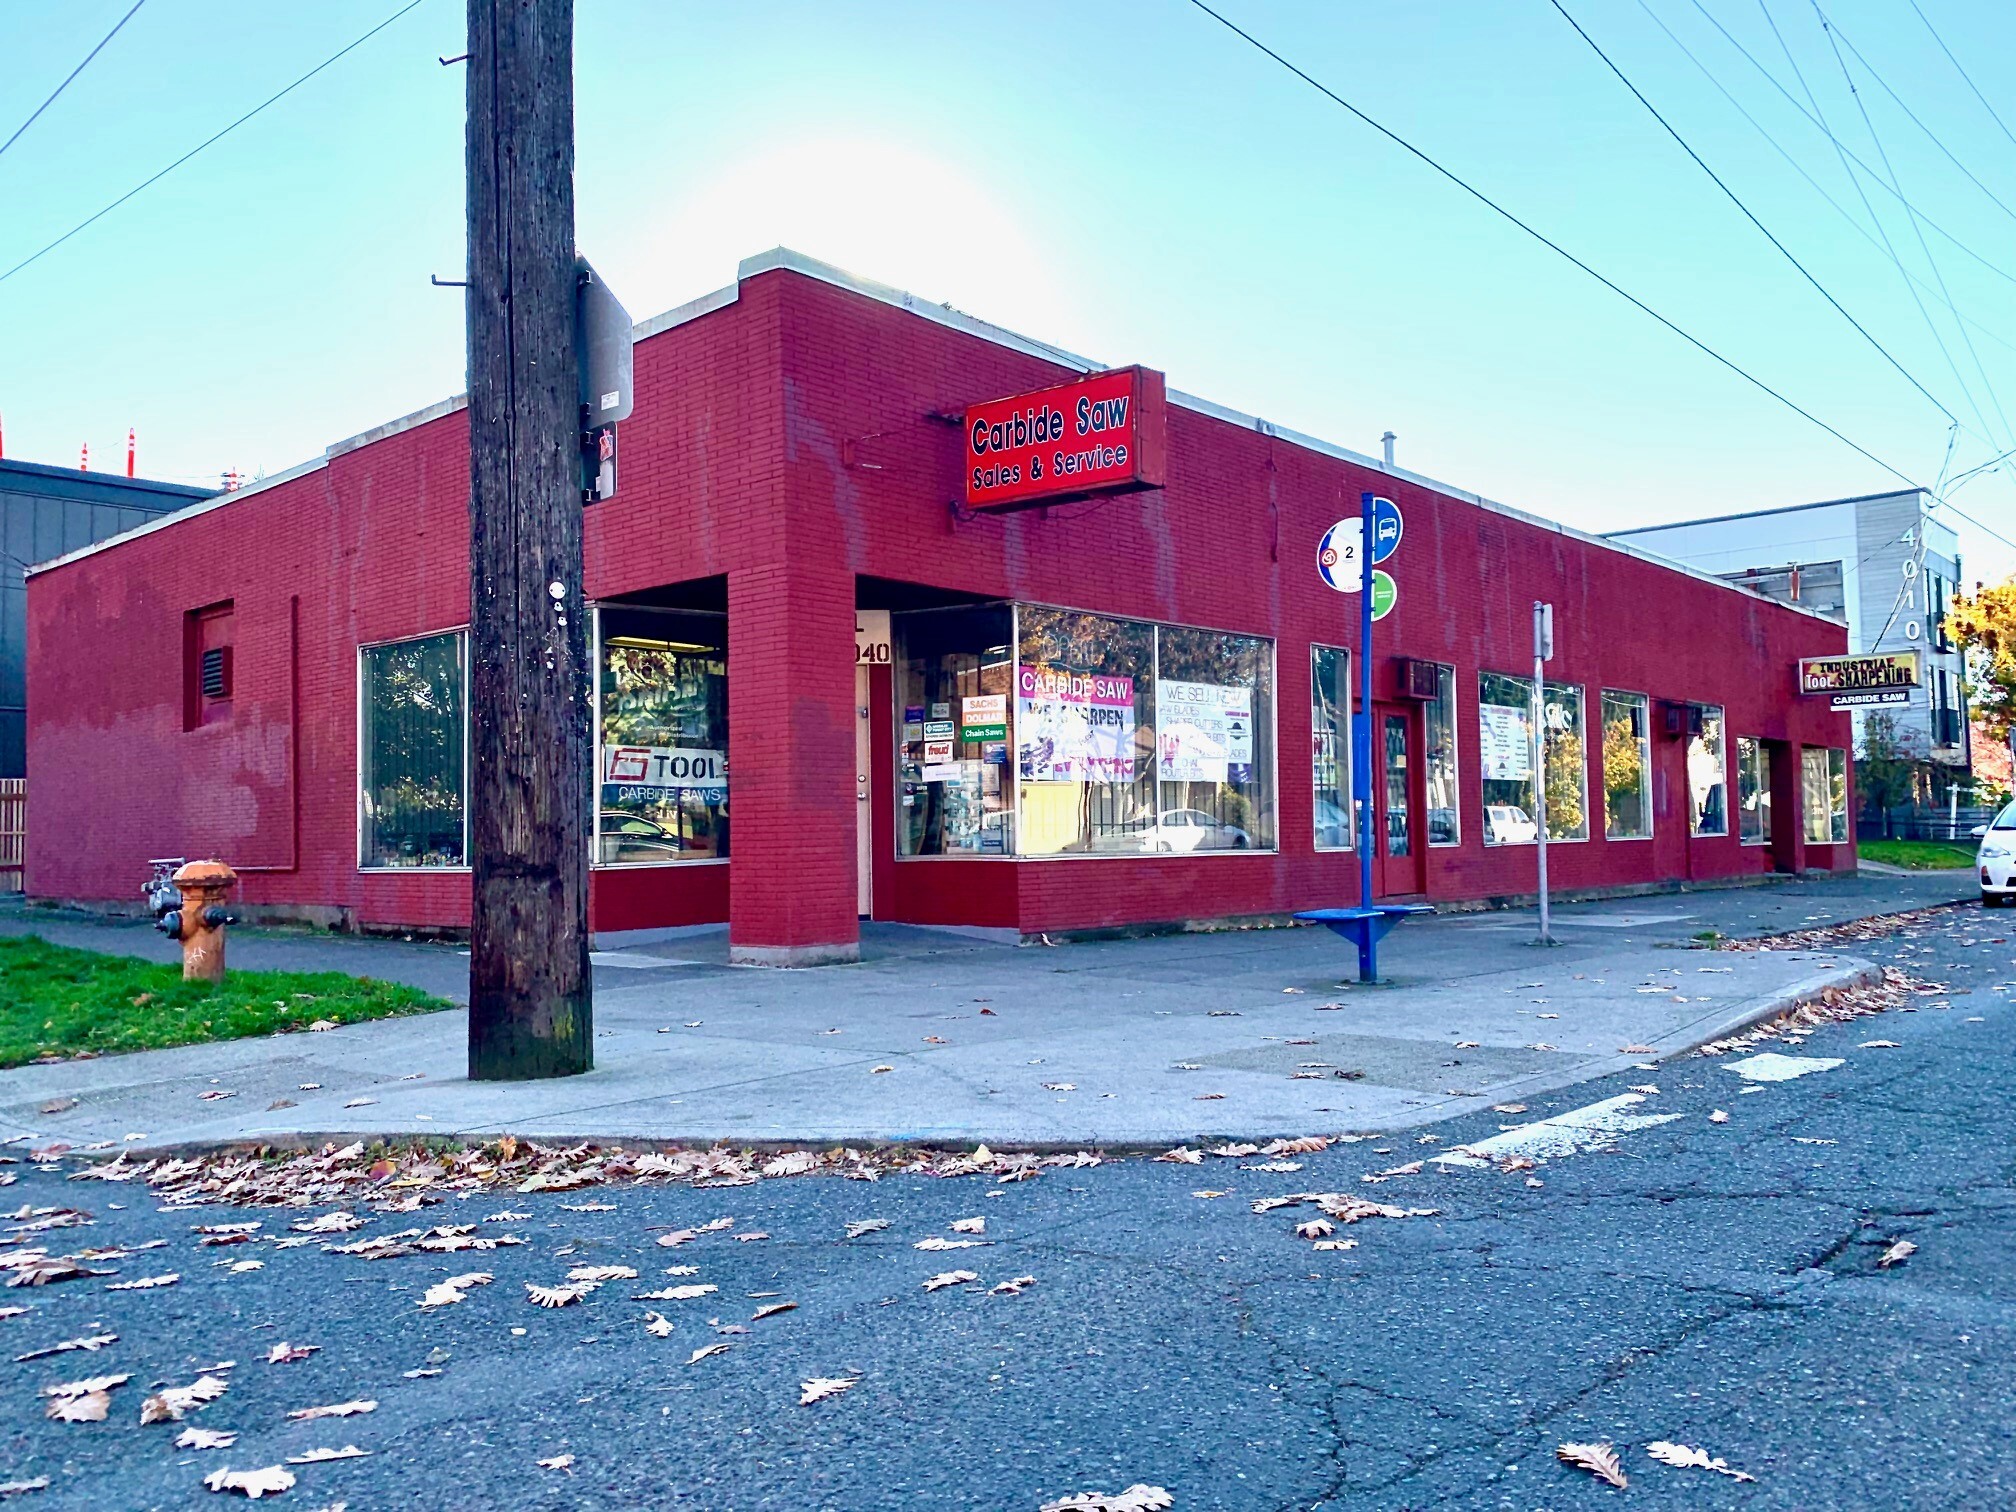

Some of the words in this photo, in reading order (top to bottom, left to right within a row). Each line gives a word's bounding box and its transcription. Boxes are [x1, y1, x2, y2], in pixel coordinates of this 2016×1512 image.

[971, 404, 1064, 456] Carbide
[1076, 396, 1129, 436] Saw
[972, 463, 1021, 490] Sales
[1030, 455, 1043, 480] &
[1053, 444, 1128, 477] Service
[1345, 546, 1354, 559] 2
[1901, 528, 1921, 640] 4010
[1820, 657, 1895, 673] INDUSTRIAL
[1805, 674, 1834, 688] TOOL
[1838, 667, 1912, 687] SHARPENING
[1022, 672, 1092, 697] CARBIDE
[1096, 680, 1128, 700] SAW
[1166, 685, 1184, 701] WE
[1833, 694, 1880, 705] CARBIDE
[1882, 693, 1906, 702] SAW
[965, 729, 985, 738] Chain
[985, 728, 1004, 736] Saws
[619, 786, 675, 801] CARBIDE
[682, 788, 721, 801] SAWS
